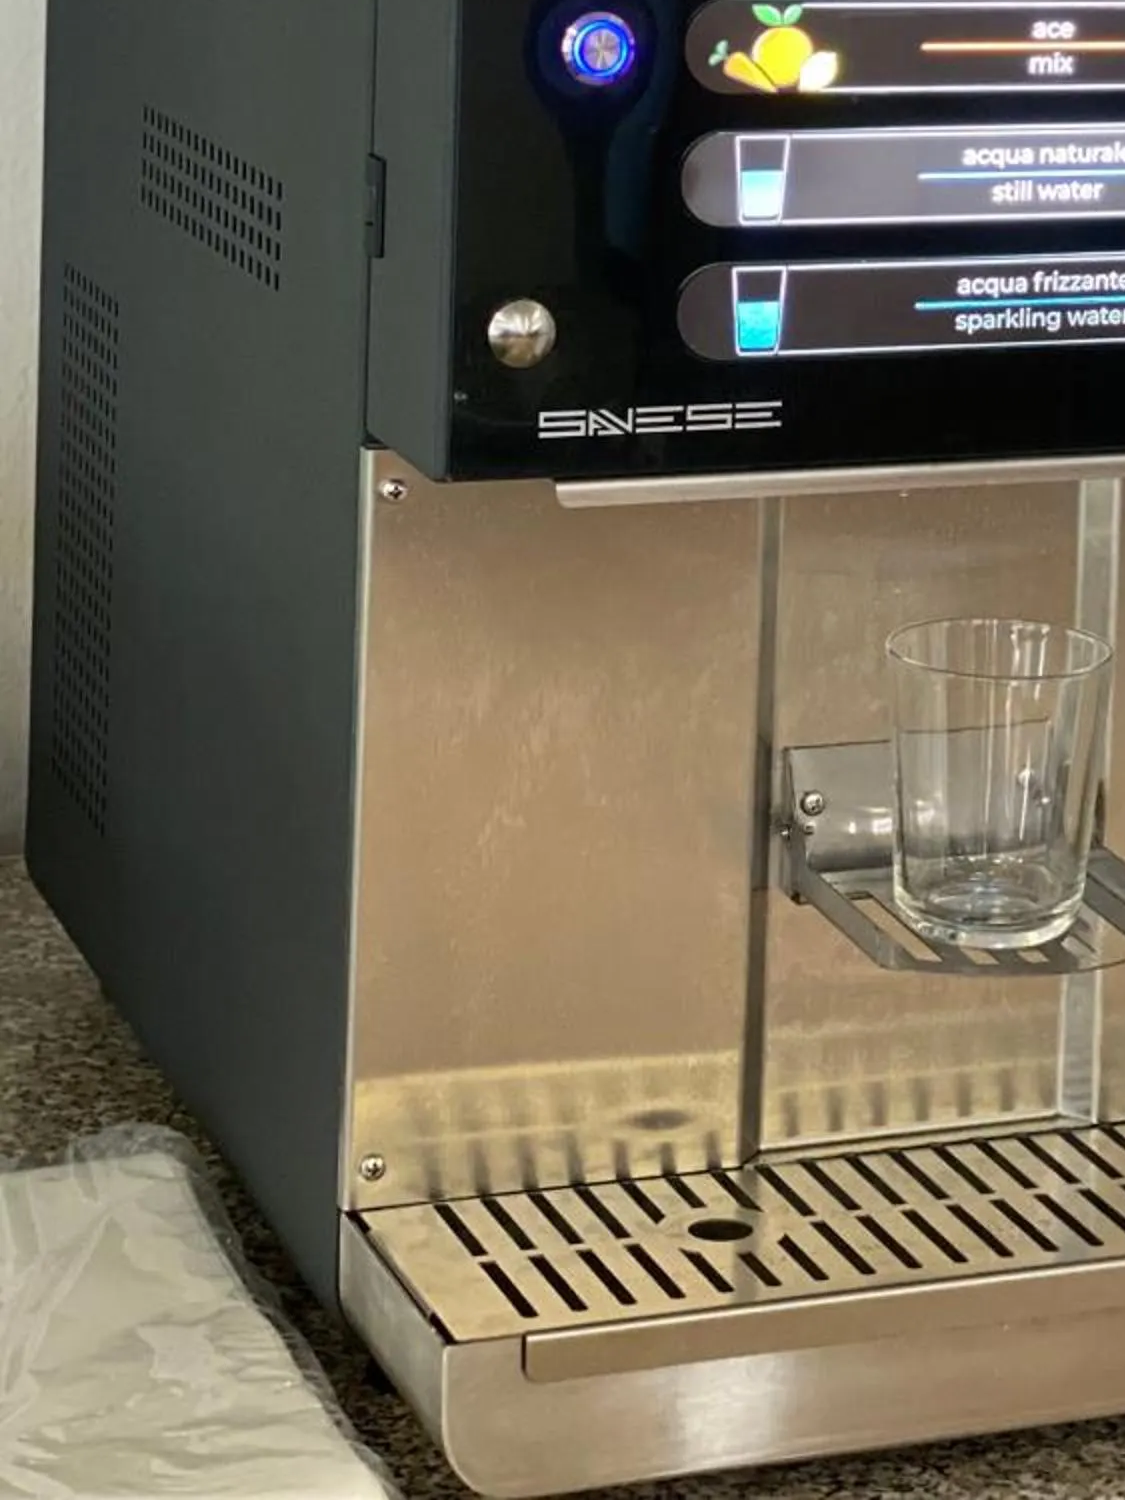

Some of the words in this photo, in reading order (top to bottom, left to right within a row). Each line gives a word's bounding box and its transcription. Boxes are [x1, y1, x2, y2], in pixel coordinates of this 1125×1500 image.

[1030, 20, 1076, 39] ace
[1028, 51, 1074, 75] mix
[961, 147, 1034, 170] acqua
[991, 180, 1033, 203] still
[1037, 180, 1104, 202] water
[956, 276, 1028, 298] acqua
[954, 307, 1061, 335] sparkling
